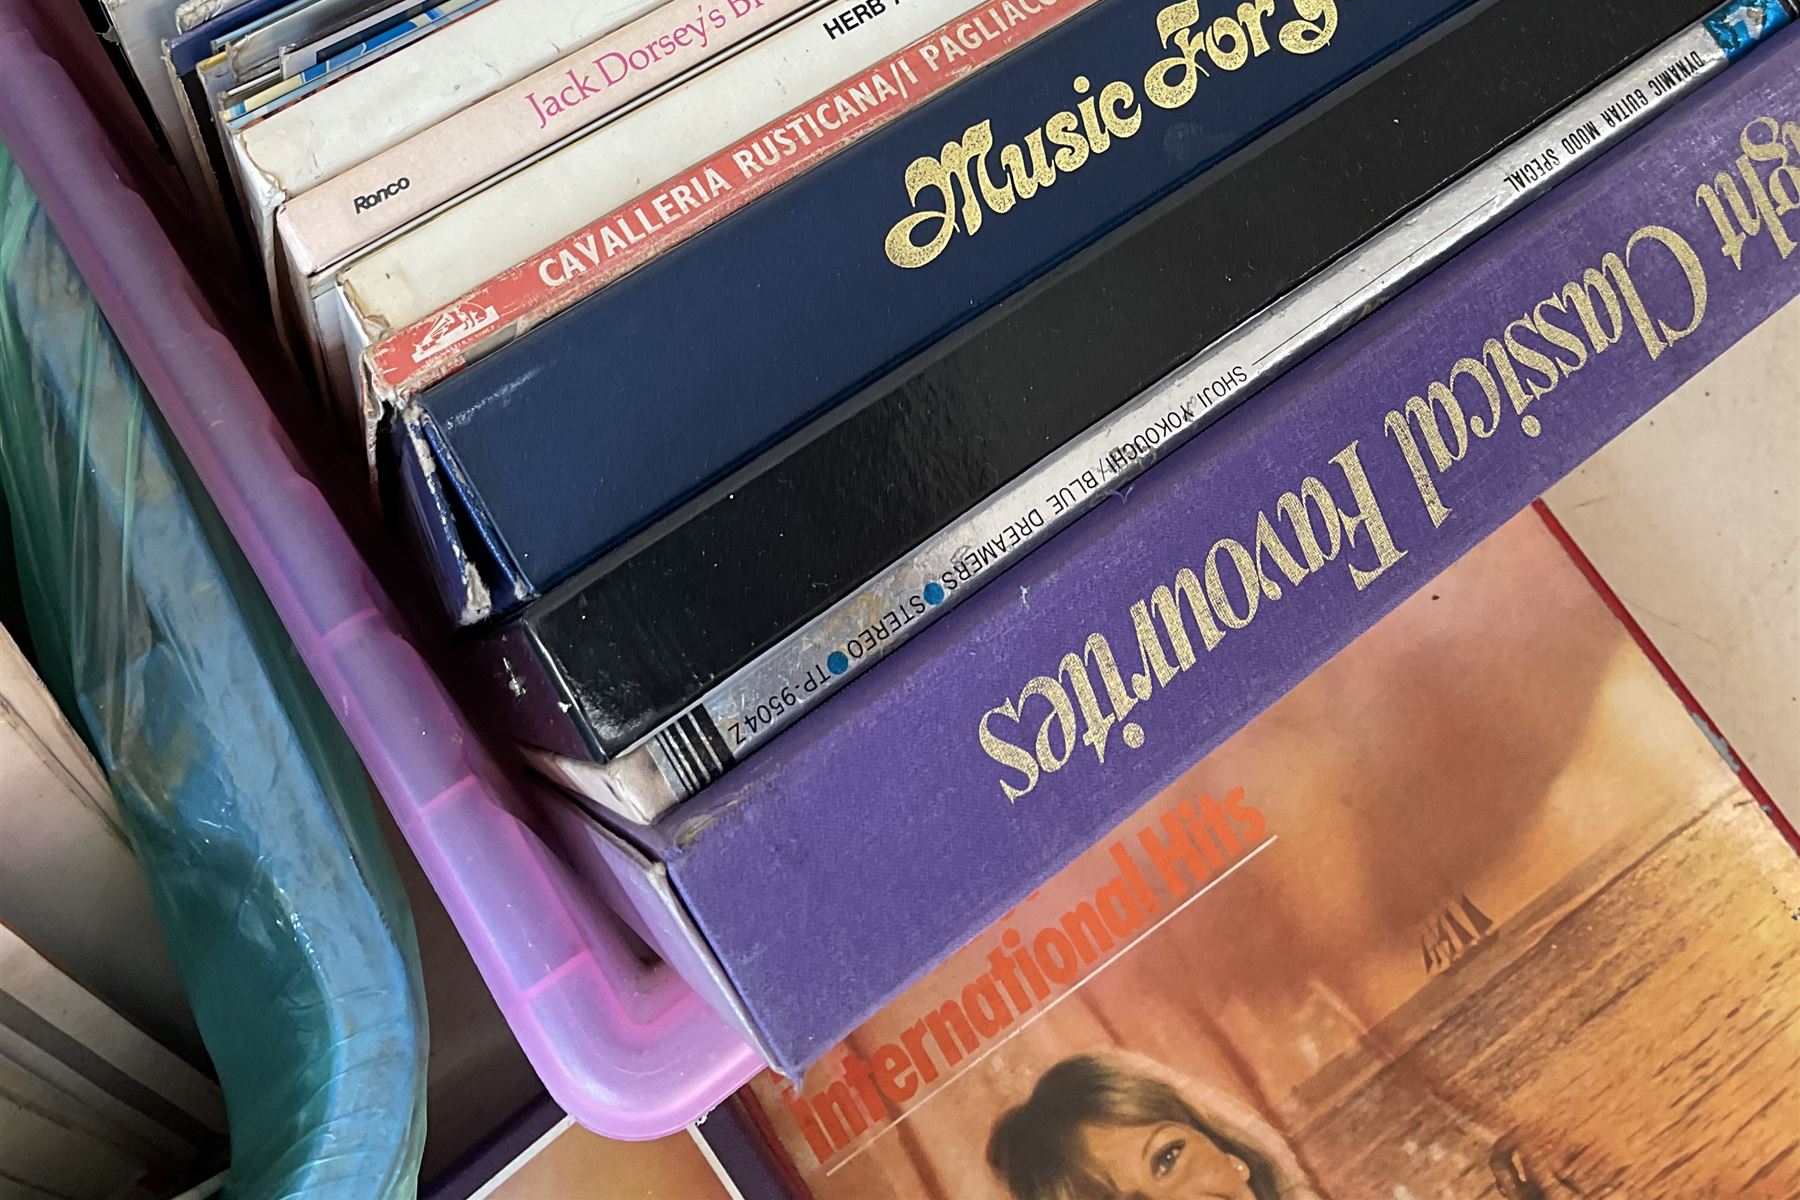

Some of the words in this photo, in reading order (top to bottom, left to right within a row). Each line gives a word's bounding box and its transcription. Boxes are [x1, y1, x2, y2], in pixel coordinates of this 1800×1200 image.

[524, 70, 603, 129] Jack
[592, 3, 727, 88] Dorsey's
[1648, 50, 1705, 96] DYNAMIC
[1561, 120, 1601, 155] MOOD
[1600, 88, 1649, 128] GUITAR
[353, 177, 411, 215] Ronco
[538, 168, 732, 287] CAVALLERIA
[731, 59, 919, 178] RUSTICANA/I
[883, 75, 1143, 269] Music
[1503, 148, 1561, 192] SPECIAL
[1195, 364, 1249, 409] SHOJI
[1383, 225, 1708, 530] Classical
[940, 507, 1045, 591] DREAMERS
[847, 594, 926, 659] STEREO
[978, 439, 1408, 804] Favourites
[781, 841, 1161, 1165] International
[1138, 785, 1268, 901] Hits
